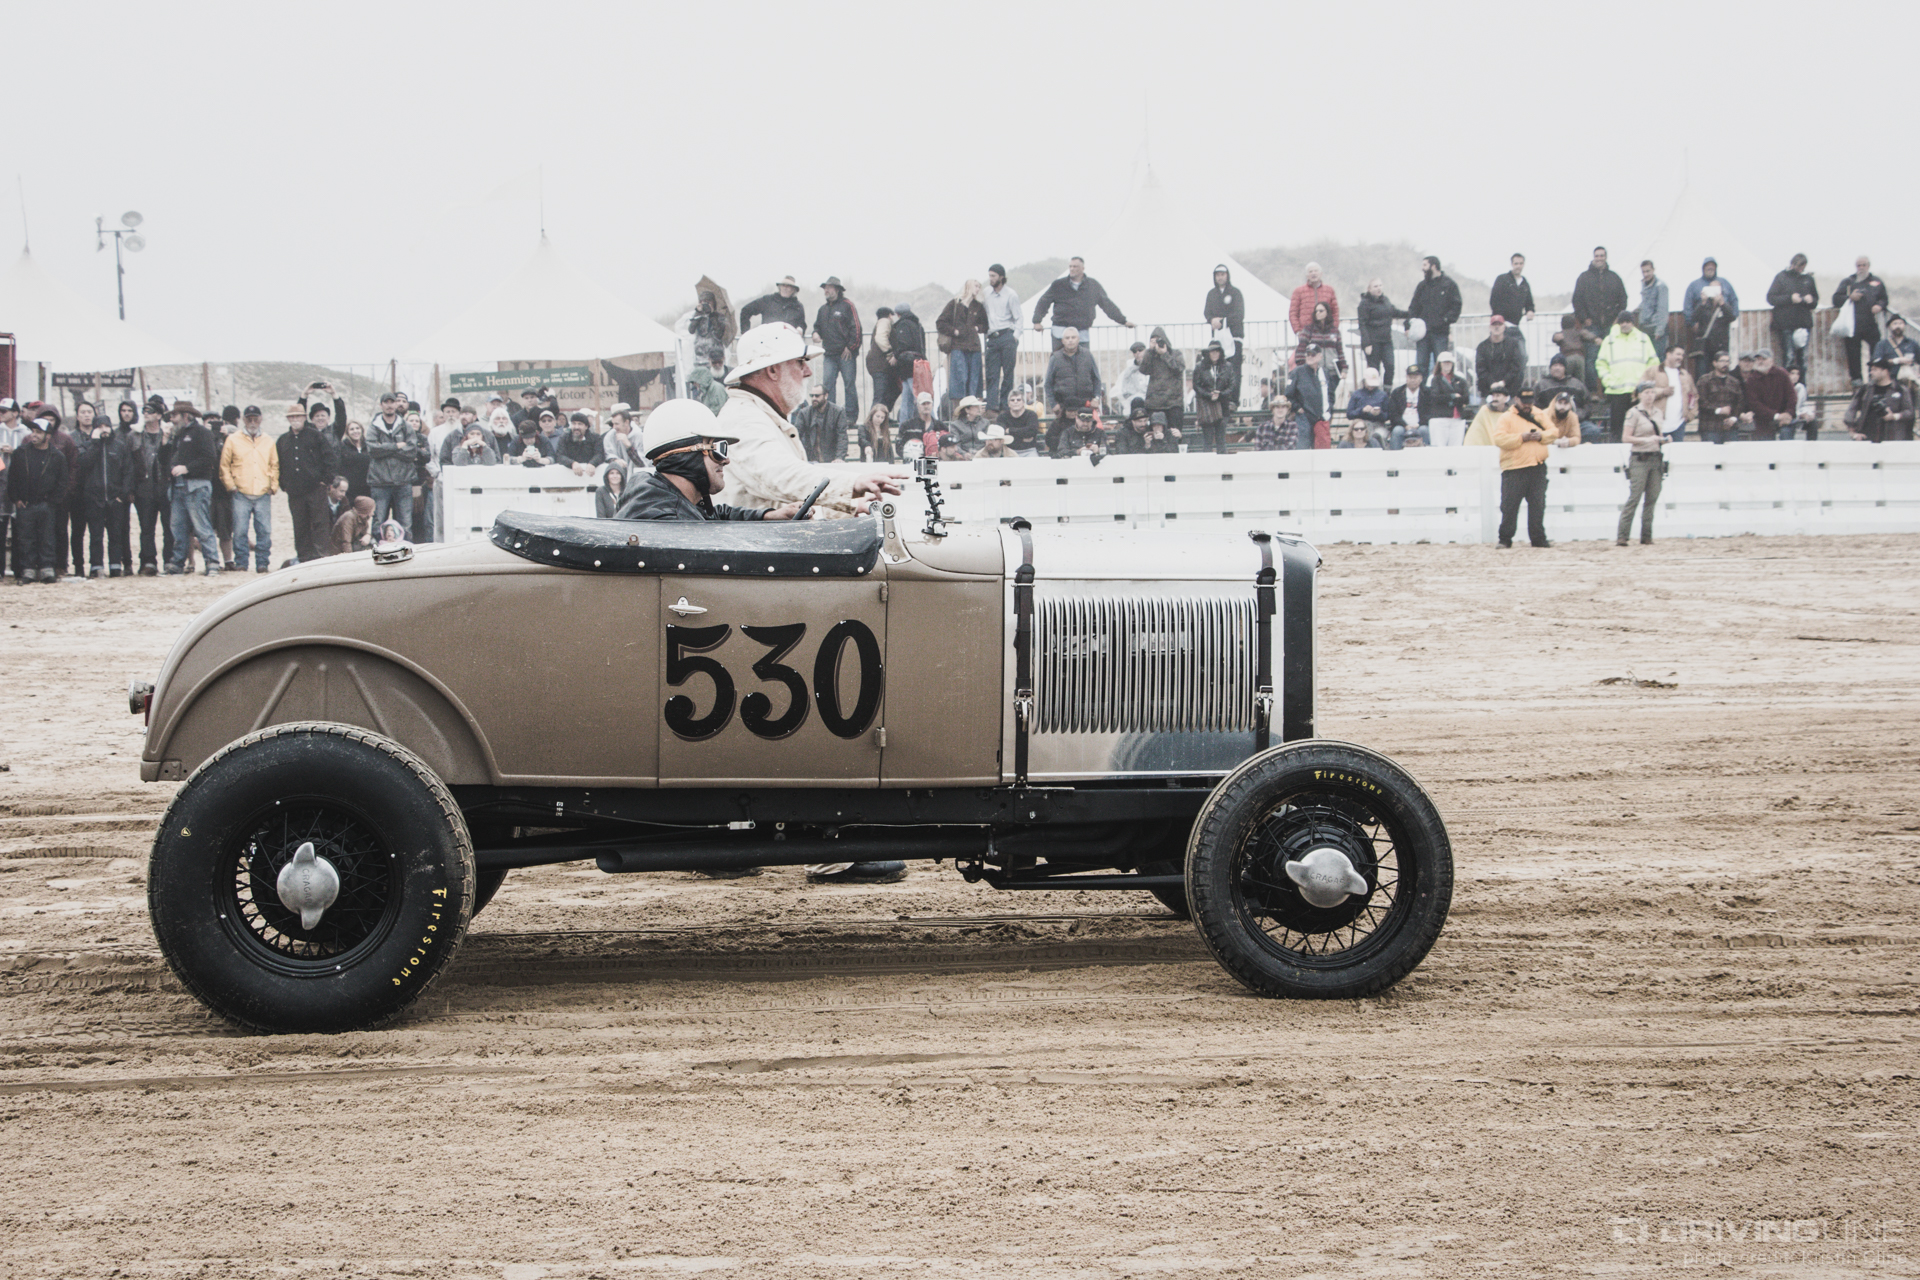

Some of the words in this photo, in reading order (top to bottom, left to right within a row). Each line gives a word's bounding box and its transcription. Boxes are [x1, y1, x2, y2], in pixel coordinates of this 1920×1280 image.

[486, 374, 541, 386] Hemmings
[664, 619, 883, 741] 530
[1314, 770, 1383, 795] Firestone
[392, 887, 447, 986] Firestone
